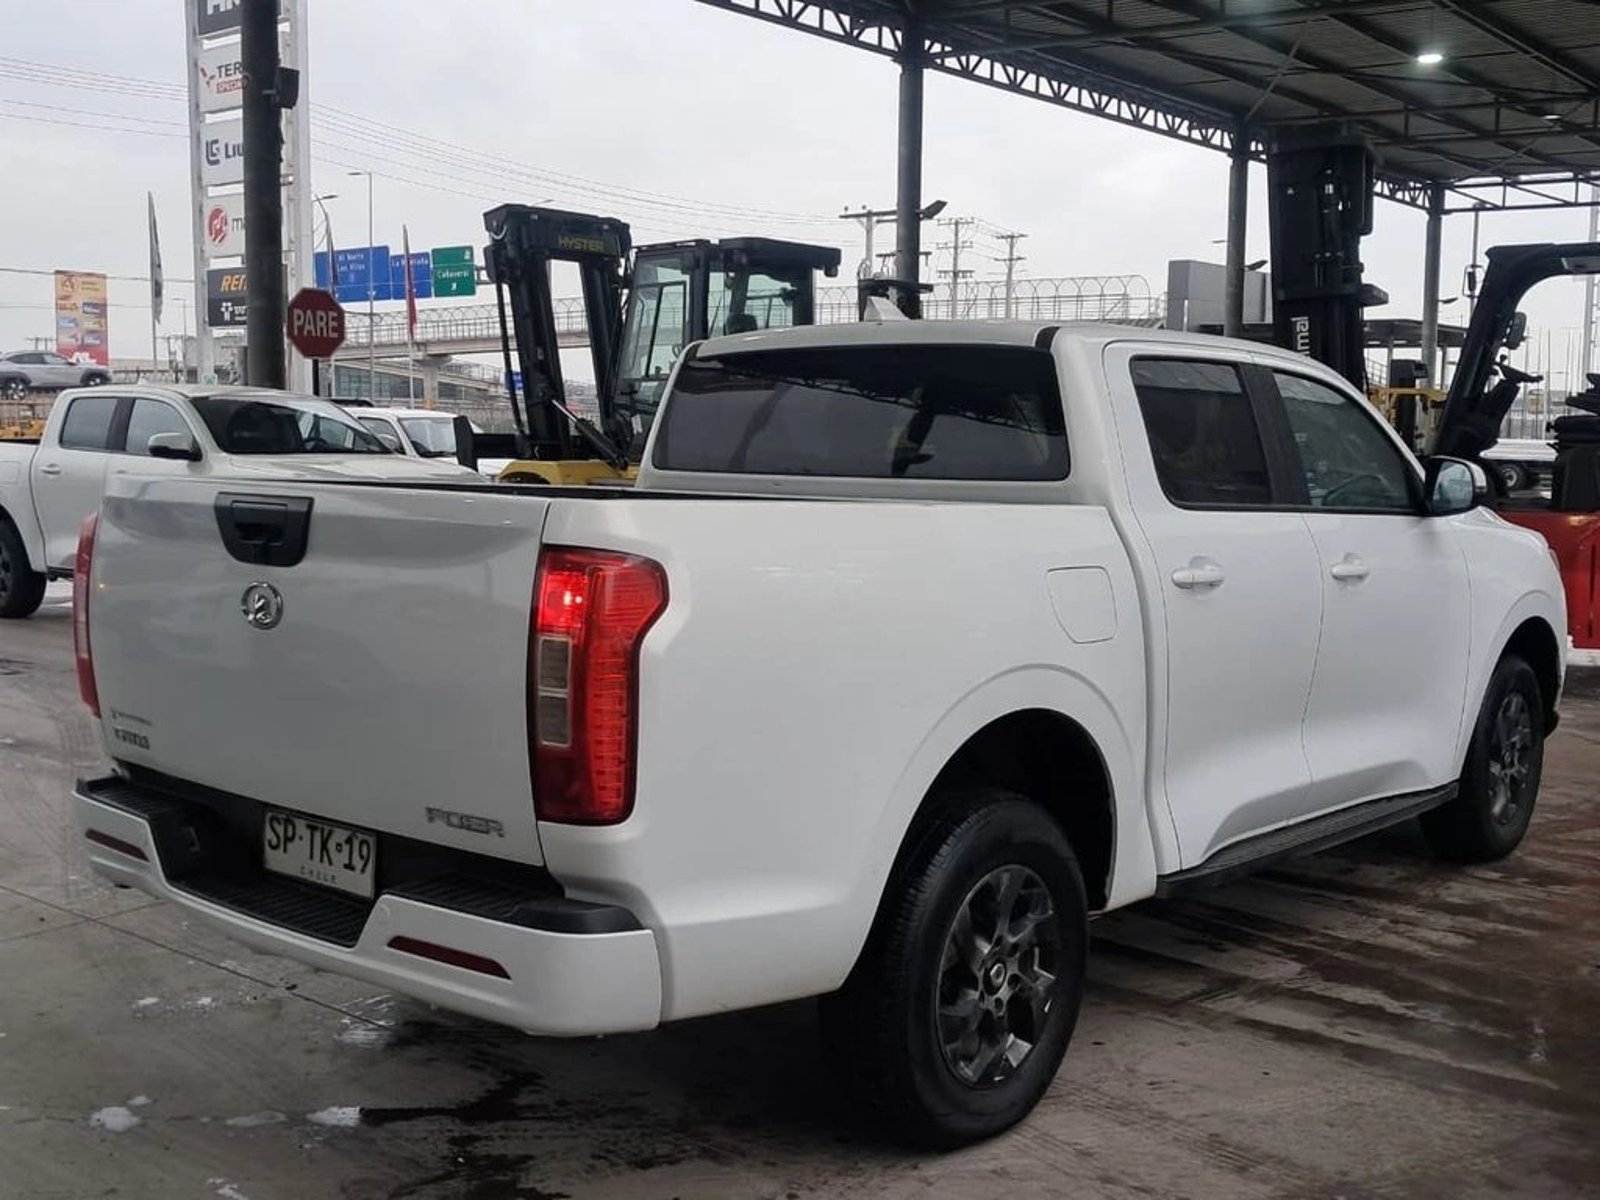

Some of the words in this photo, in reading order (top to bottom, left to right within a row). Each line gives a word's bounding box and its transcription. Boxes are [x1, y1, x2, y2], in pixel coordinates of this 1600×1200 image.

[216, 61, 243, 79] TER
[558, 235, 605, 252] HYSTER
[293, 308, 338, 338] PARE
